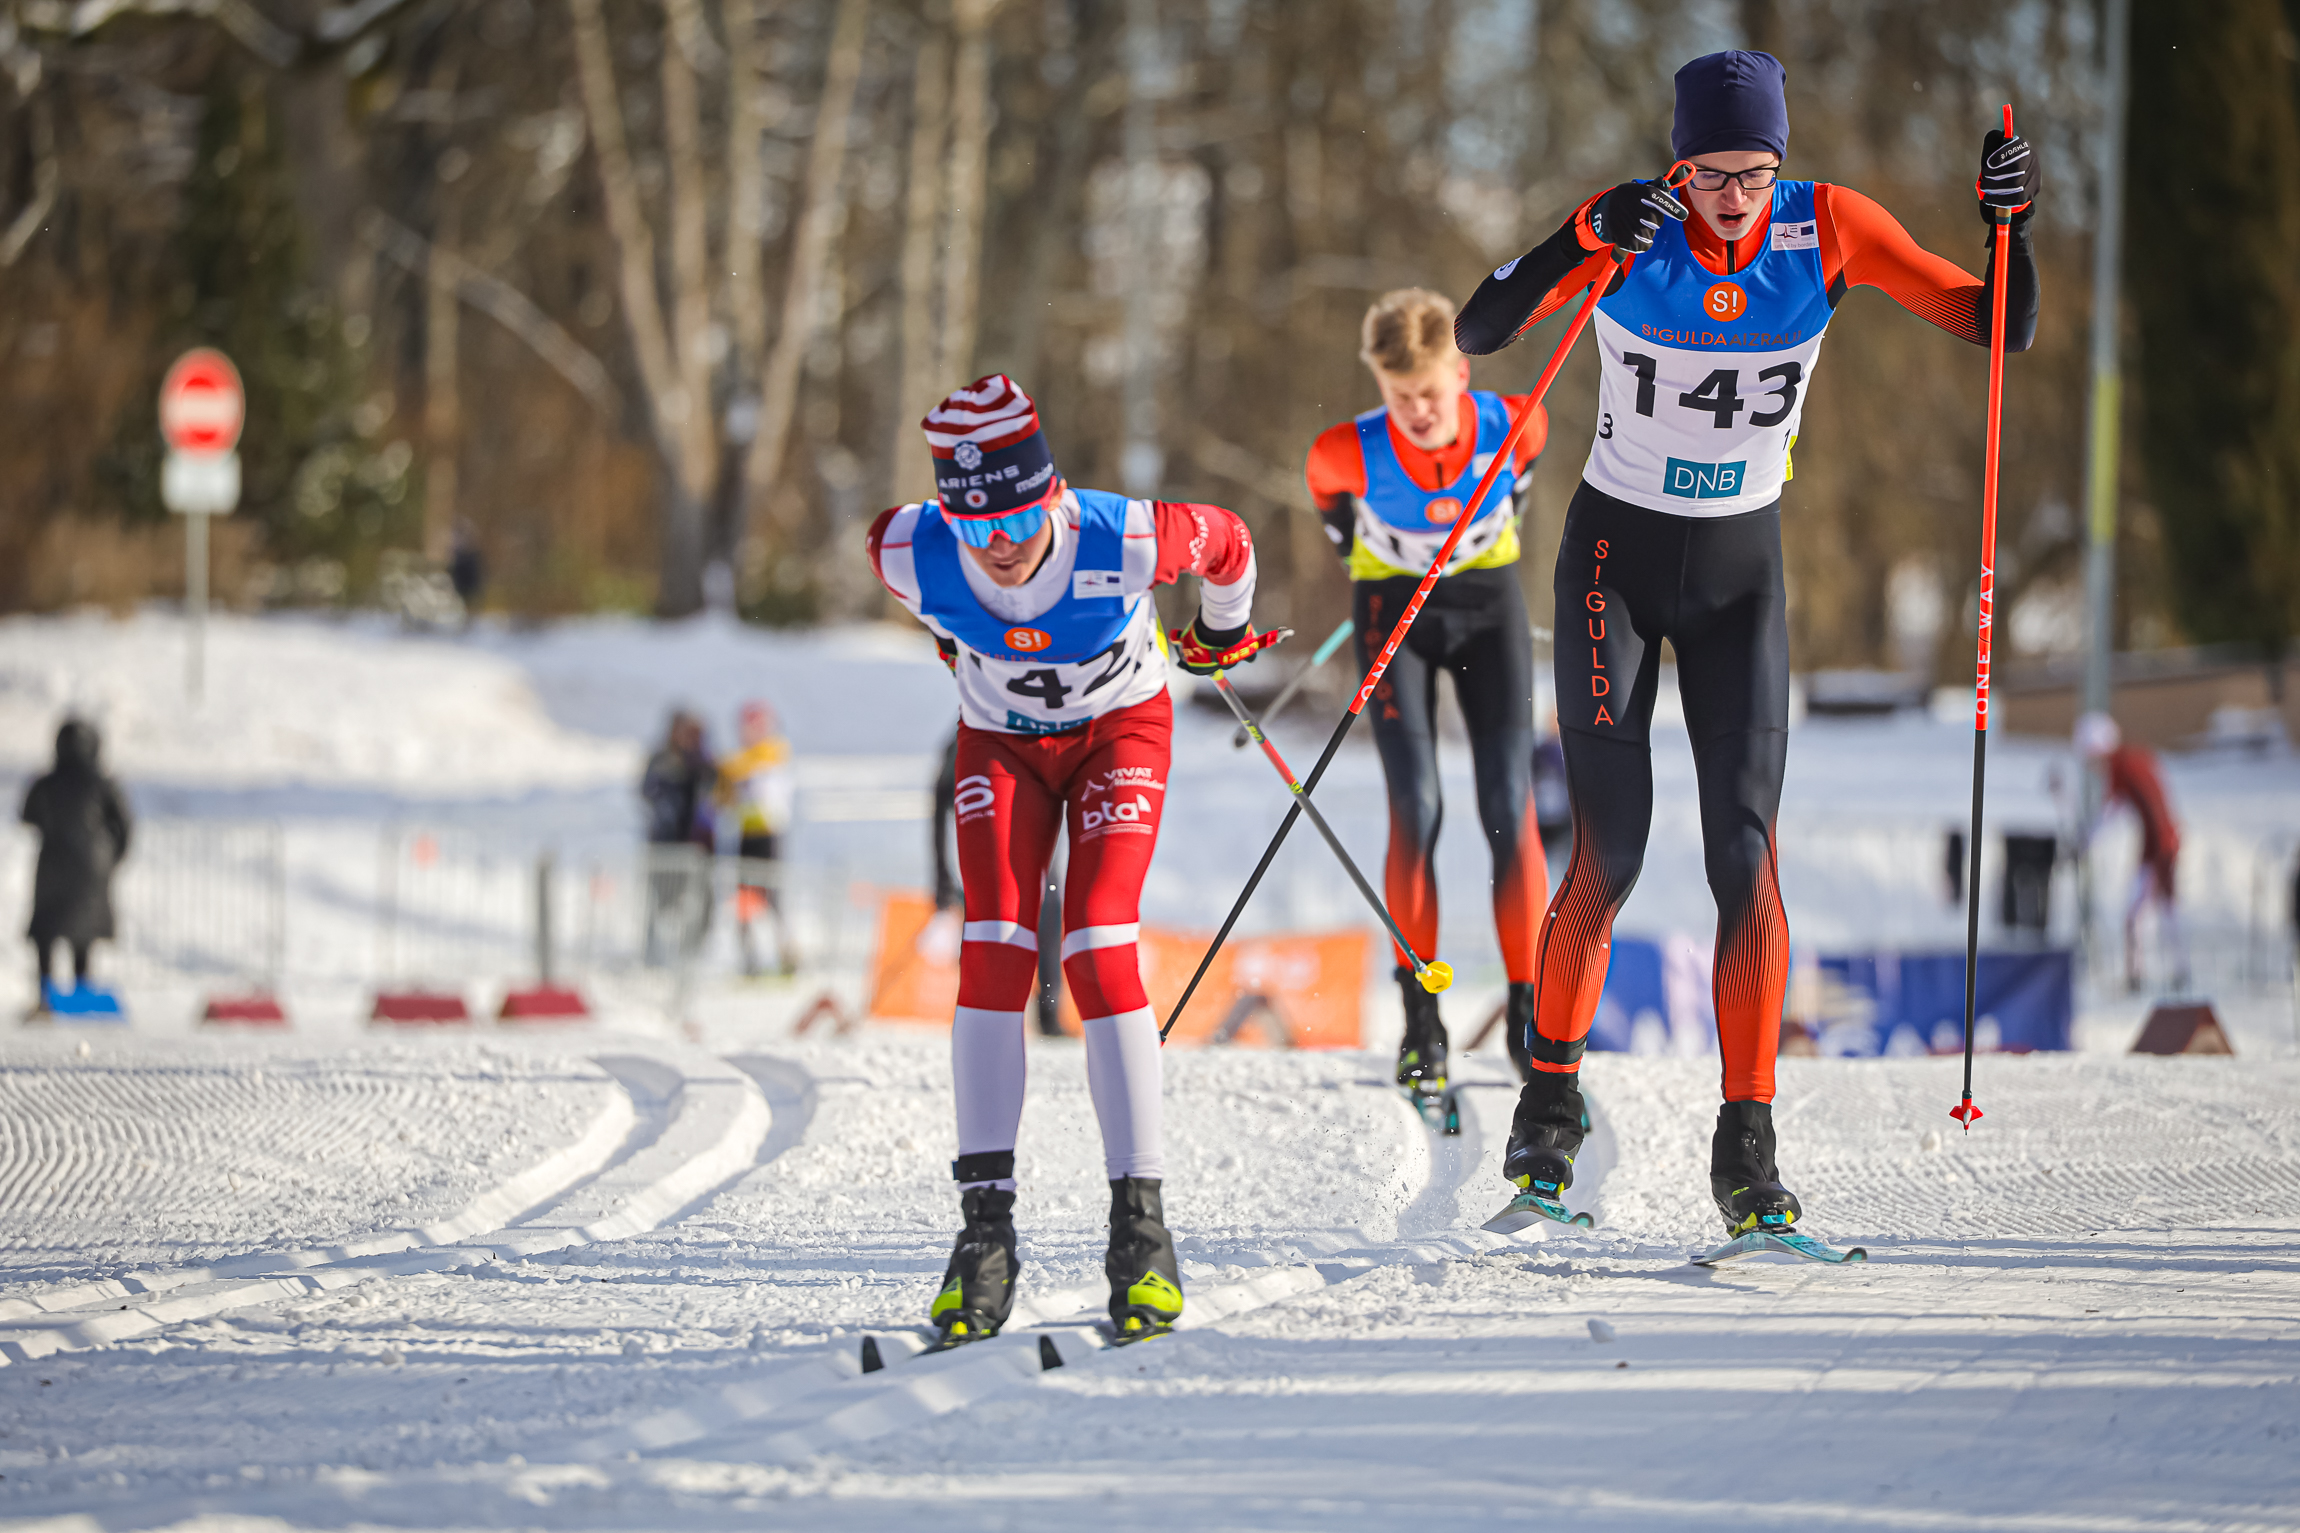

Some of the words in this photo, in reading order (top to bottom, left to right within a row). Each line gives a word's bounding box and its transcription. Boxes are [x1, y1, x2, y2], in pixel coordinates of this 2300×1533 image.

[1712, 290, 1738, 313] S!
[1622, 350, 1802, 429] 143
[938, 464, 1020, 489] ARIENS
[1674, 464, 1736, 499] DNB
[1979, 563, 1994, 630] WAY
[1012, 630, 1042, 648] S!
[1976, 650, 1991, 715] ONE
